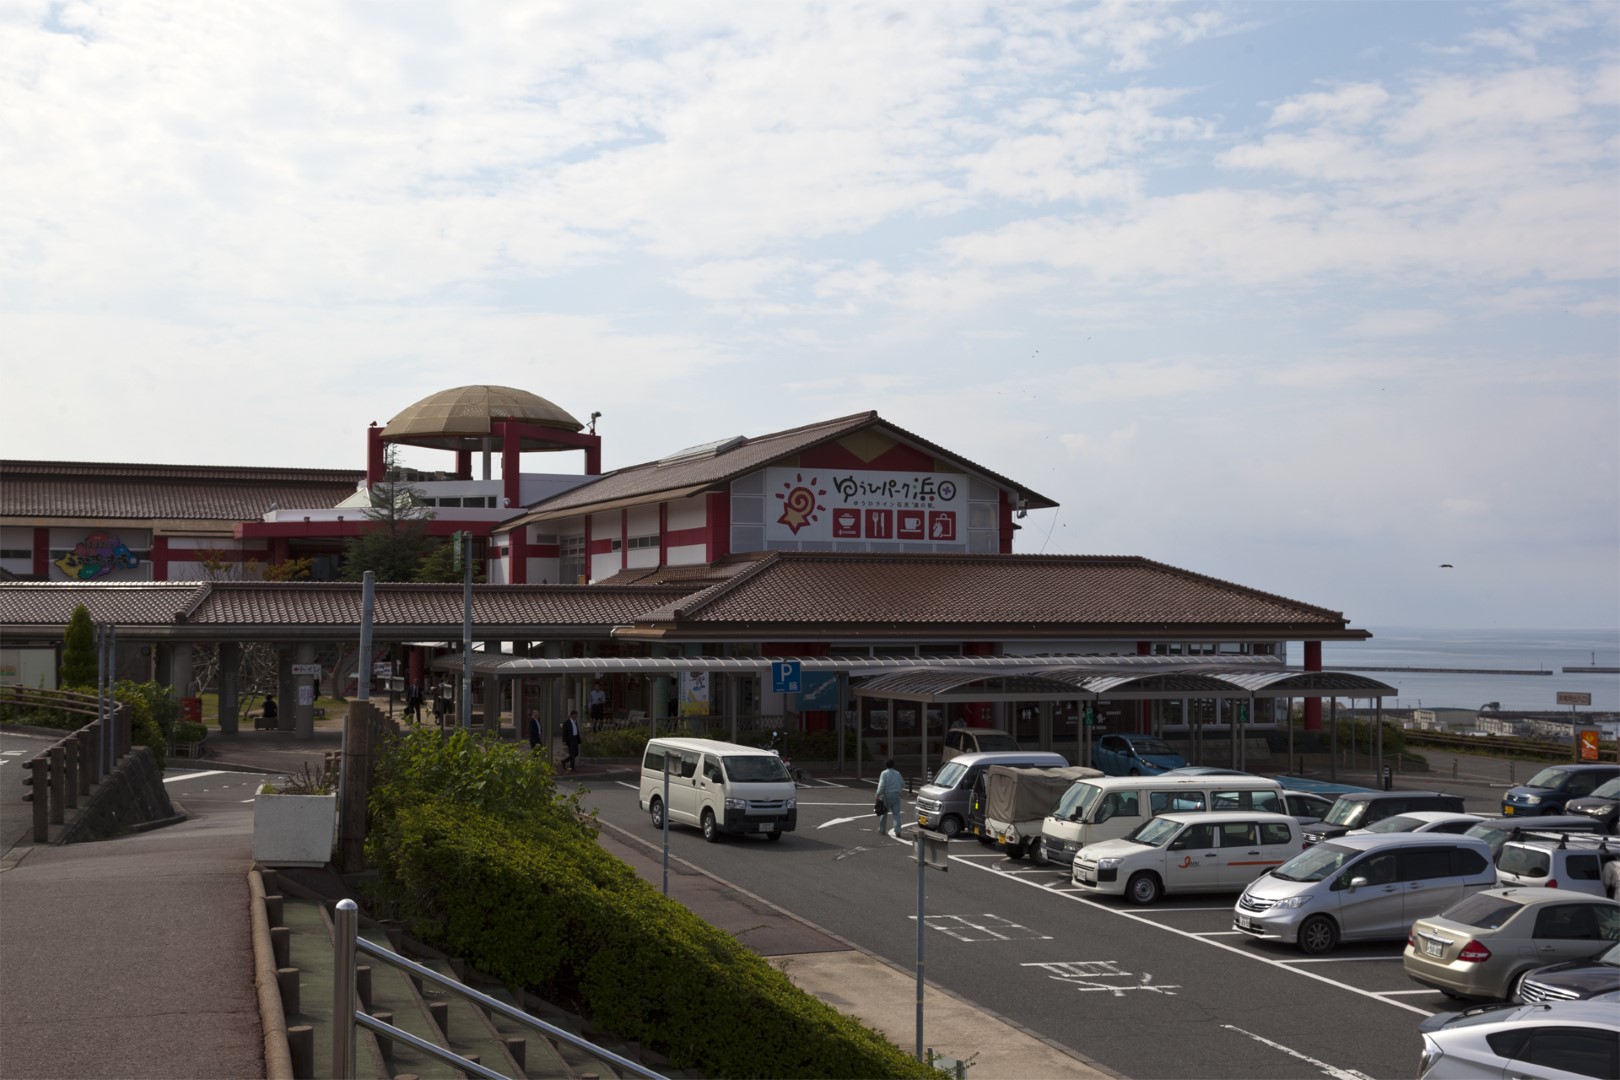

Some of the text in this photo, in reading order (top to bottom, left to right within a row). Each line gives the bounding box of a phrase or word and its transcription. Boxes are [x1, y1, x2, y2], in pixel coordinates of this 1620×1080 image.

[833, 475, 957, 503] ゆうひパーク浜田
[780, 663, 793, 682] P
